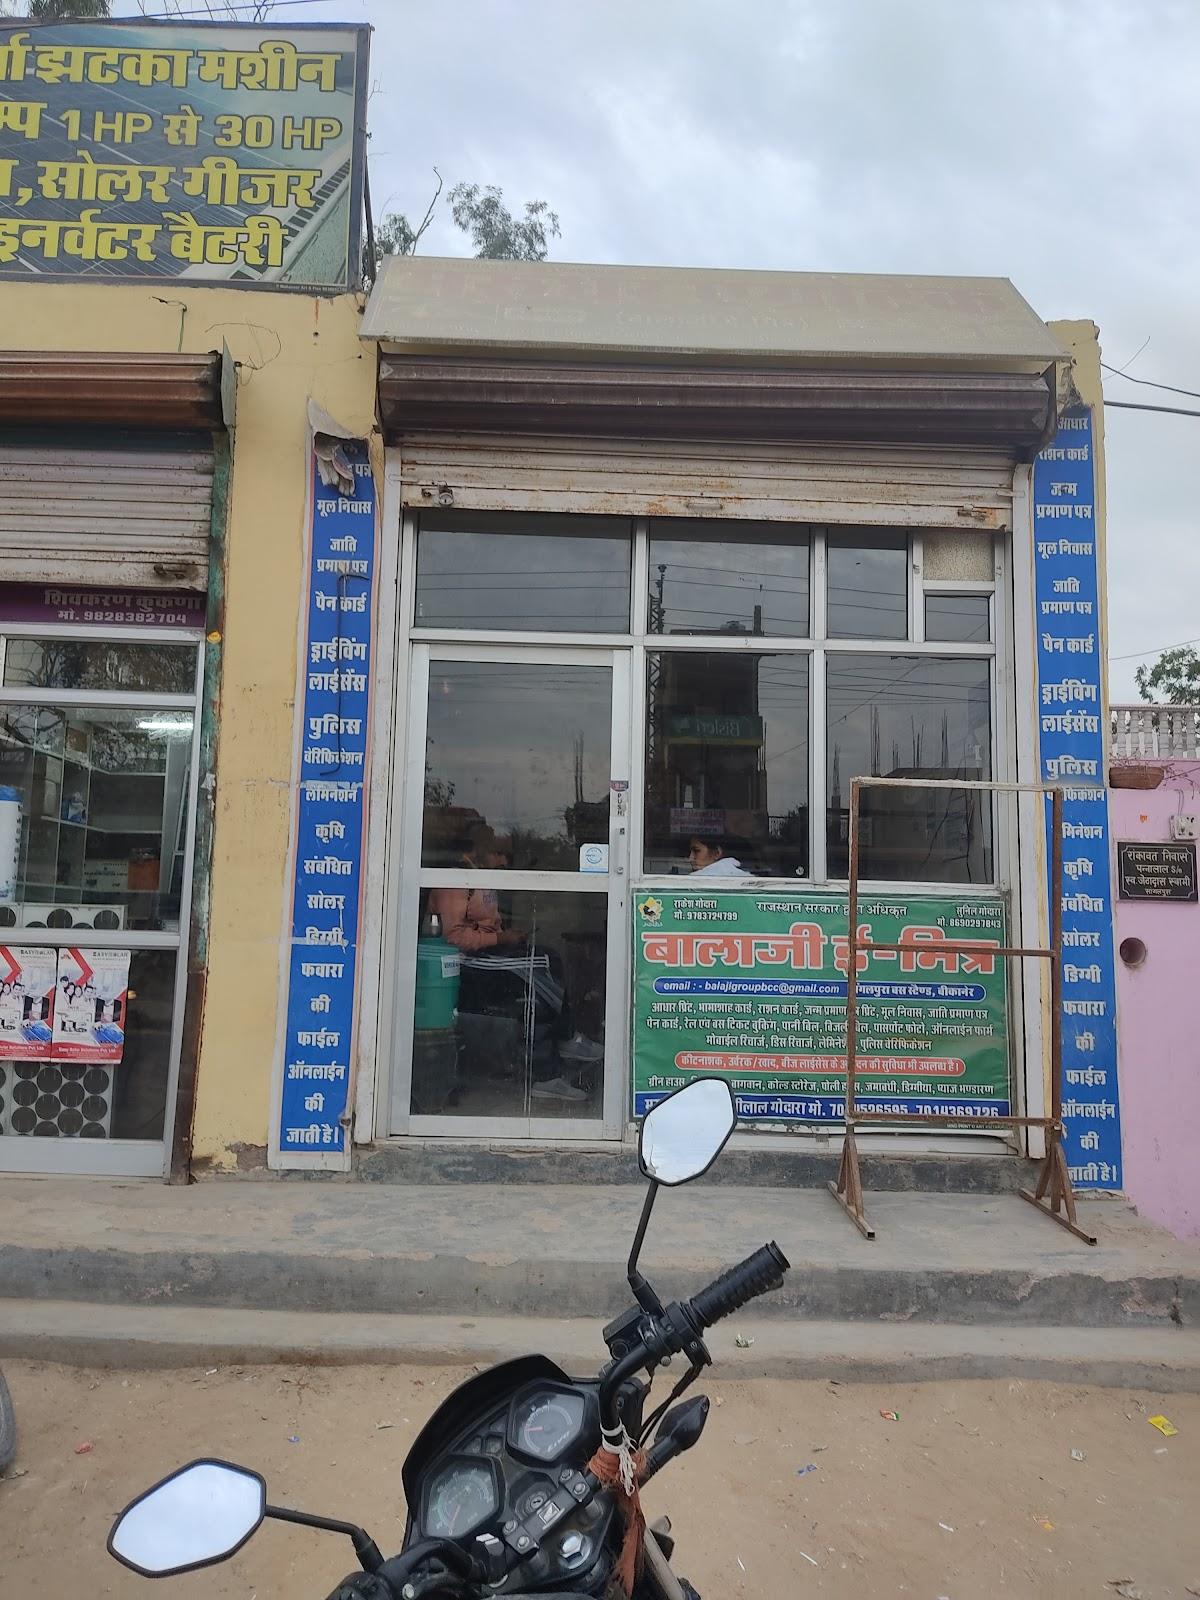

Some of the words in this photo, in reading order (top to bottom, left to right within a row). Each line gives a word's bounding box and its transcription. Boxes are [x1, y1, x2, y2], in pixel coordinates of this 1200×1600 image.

[34, 45, 194, 88] झटका
[197, 40, 342, 91] मशीन
[59, 109, 81, 141] 1
[93, 111, 153, 145] HP
[162, 104, 203, 147] से
[214, 114, 275, 149] 30
[282, 115, 343, 150] HP
[37, 149, 175, 204] सोलर
[182, 155, 322, 208] गीजर
[162, 211, 289, 267] बैटरी
[1067, 444, 1089, 461] कार्ड
[1050, 482, 1078, 496] जन्म
[316, 500, 337, 517] मूल
[338, 497, 373, 514] निवास
[1036, 503, 1073, 518] प्रमाण
[1074, 504, 1093, 519] पत्र
[330, 535, 358, 554] जाति
[1037, 542, 1058, 560] मूल
[1058, 538, 1093, 555] निवास
[350, 560, 368, 576] पत्र
[1053, 577, 1079, 593] जाति
[316, 591, 337, 613] पैन
[339, 591, 367, 613] कार्ड
[1041, 600, 1076, 615] प्रमाण
[1077, 601, 1092, 615] पत्र
[311, 636, 367, 664] ड्राईविंग
[1042, 633, 1065, 654] पैन
[1067, 634, 1095, 654] कार्ड
[309, 670, 367, 694] लाईसेंस
[1041, 677, 1097, 704] ड्राईविंग
[309, 714, 362, 740] पुलिस
[1042, 709, 1099, 736] लाईसेंस
[1046, 757, 1098, 780] पुलिस
[315, 820, 346, 844] कृषि
[1162, 849, 1189, 862] निवास
[1063, 858, 1093, 880] कृषि
[307, 890, 345, 910] सोलर
[756, 900, 801, 914] राजस्थान
[804, 903, 840, 915] सरकार
[867, 902, 907, 919] अधिकृत
[641, 922, 828, 968] बालाजी
[1062, 930, 1100, 948] सोलर
[301, 963, 344, 978] फवारा
[1064, 963, 1103, 984] डिग्गी
[663, 981, 691, 991] email
[310, 996, 331, 1014] की
[651, 1002, 677, 1013] आधार
[757, 1004, 780, 1015] राशन
[881, 1007, 896, 1020] मूल
[927, 1006, 948, 1018] जाति
[1063, 1000, 1105, 1017] फवारा
[684, 1016, 698, 1029] रेल
[974, 1024, 994, 1036] फार्म
[297, 1028, 340, 1050] फाईल
[860, 1037, 883, 1052] पुलिस
[1075, 1032, 1095, 1052] की
[288, 1059, 345, 1082] ऑनलाईन
[1065, 1067, 1107, 1088] फाईल
[304, 1092, 325, 1114] की
[770, 1098, 807, 1115] गोदारा
[286, 1124, 321, 1146] जाती
[1080, 1131, 1099, 1150] की
